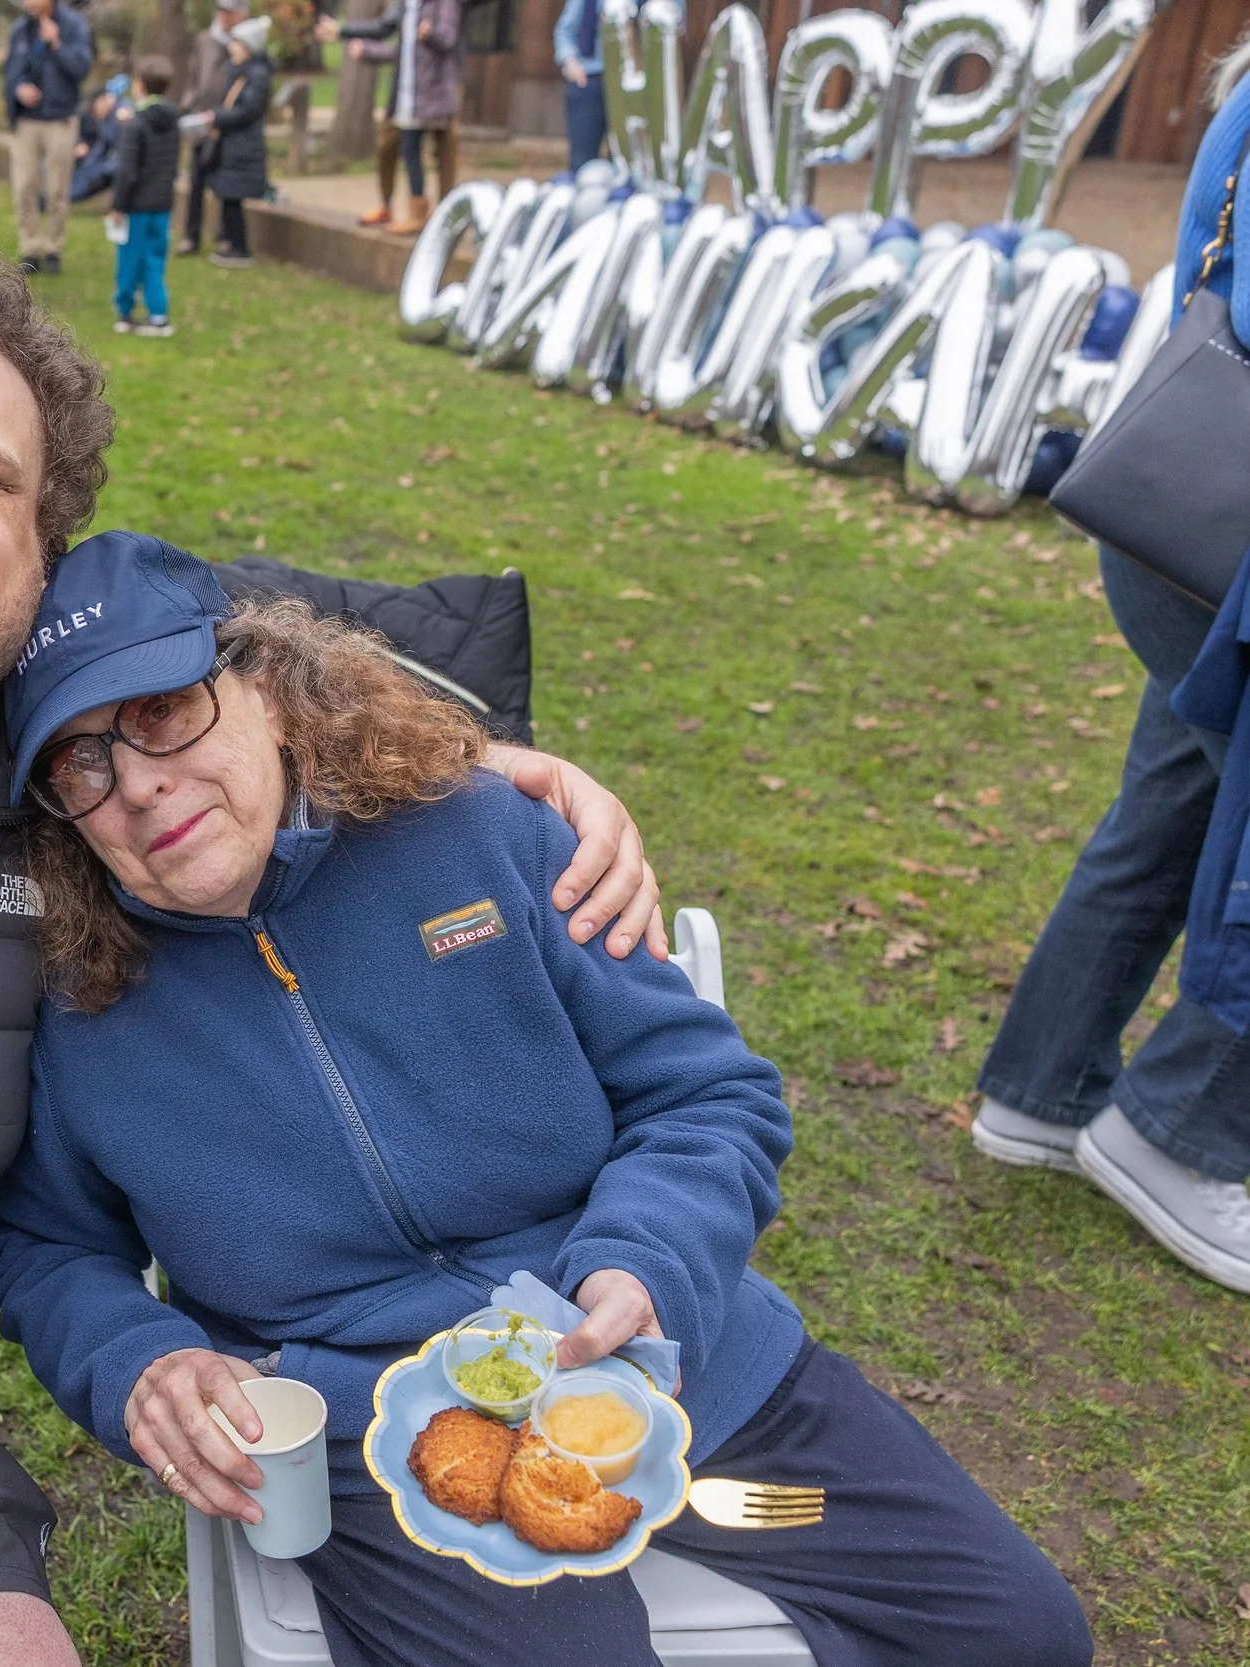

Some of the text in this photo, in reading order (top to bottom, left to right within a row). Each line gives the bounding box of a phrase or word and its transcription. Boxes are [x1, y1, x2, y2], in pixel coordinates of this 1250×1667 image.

[603, 0, 1150, 226] HAPPY
[16, 601, 103, 676] HURLEY
[1, 873, 25, 889] THE
